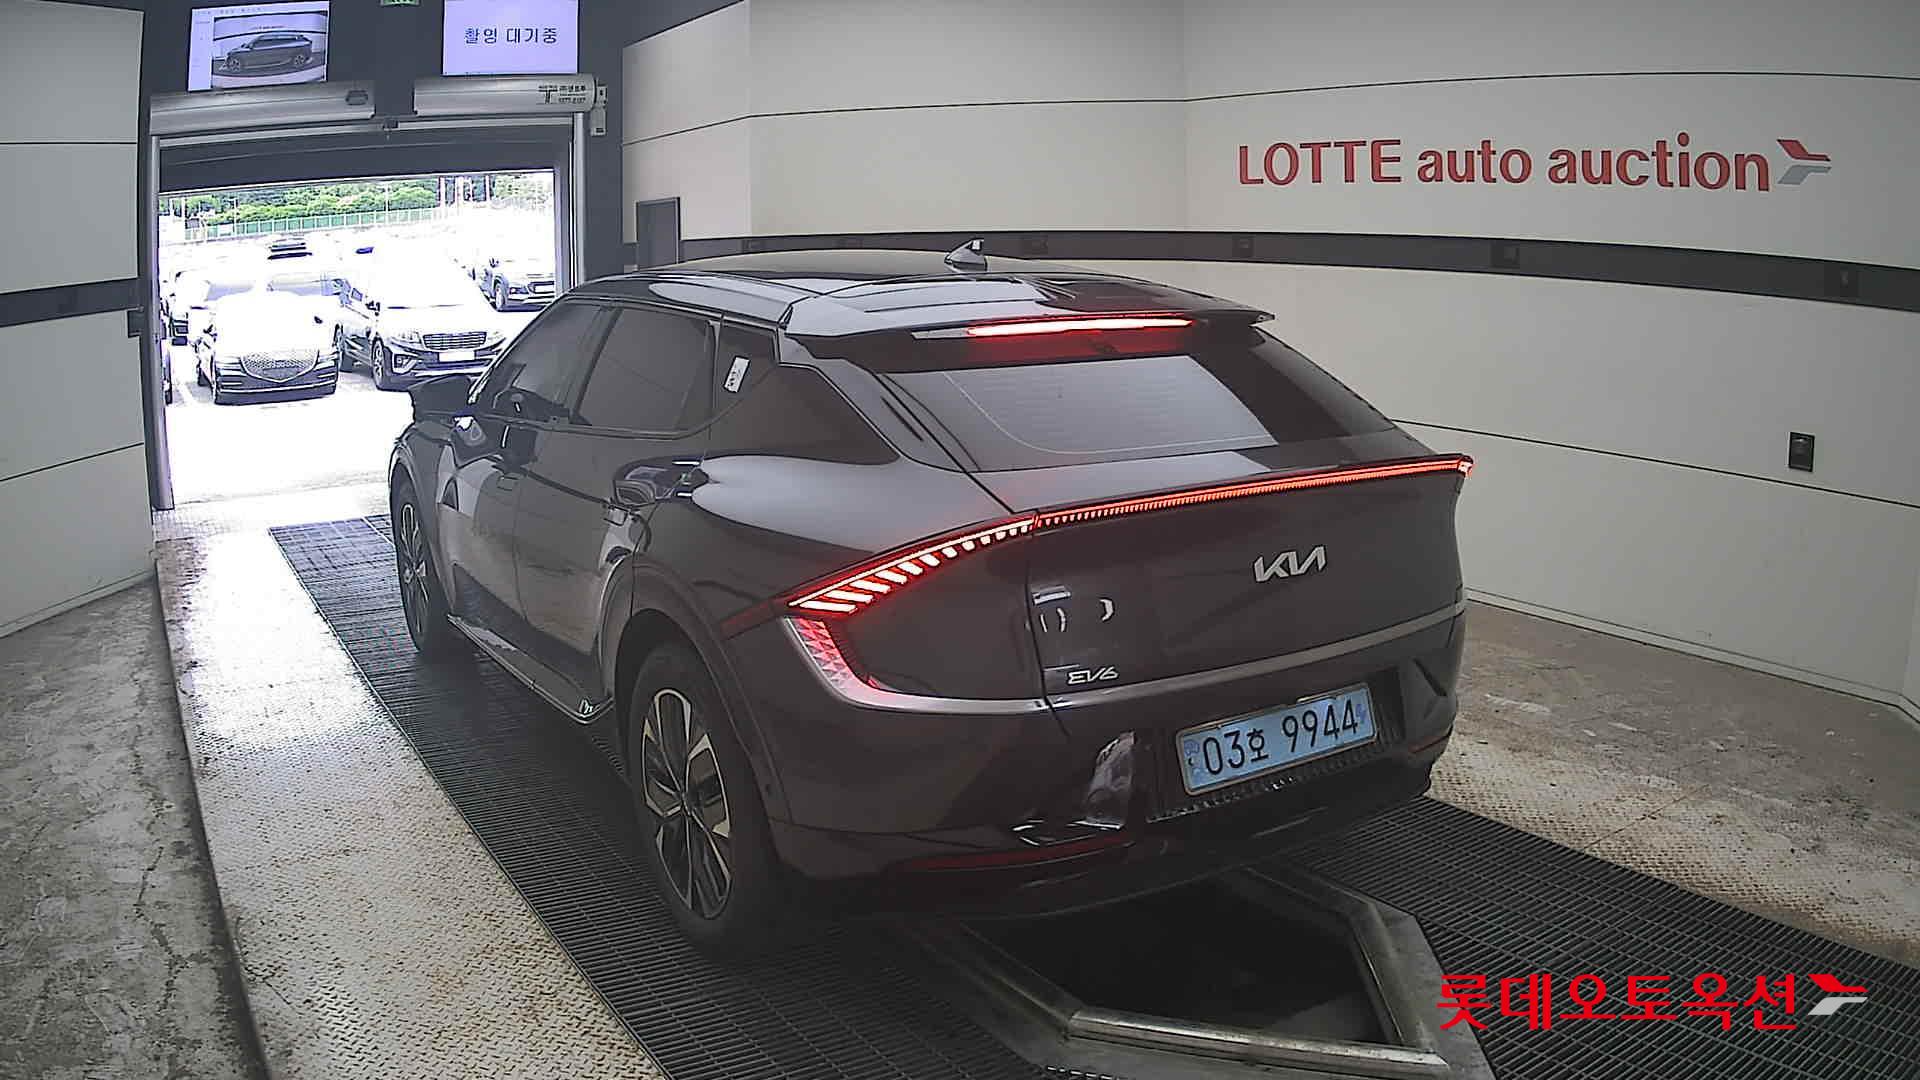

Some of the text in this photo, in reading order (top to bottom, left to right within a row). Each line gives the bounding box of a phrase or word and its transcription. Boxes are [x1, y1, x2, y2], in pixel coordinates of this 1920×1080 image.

[506, 27, 558, 45] 대기중
[1238, 131, 1770, 192] LOTTE auto auction
[1253, 545, 1327, 583] KIA
[1067, 665, 1119, 686] EV6
[1202, 699, 1359, 776] 03호 9944
